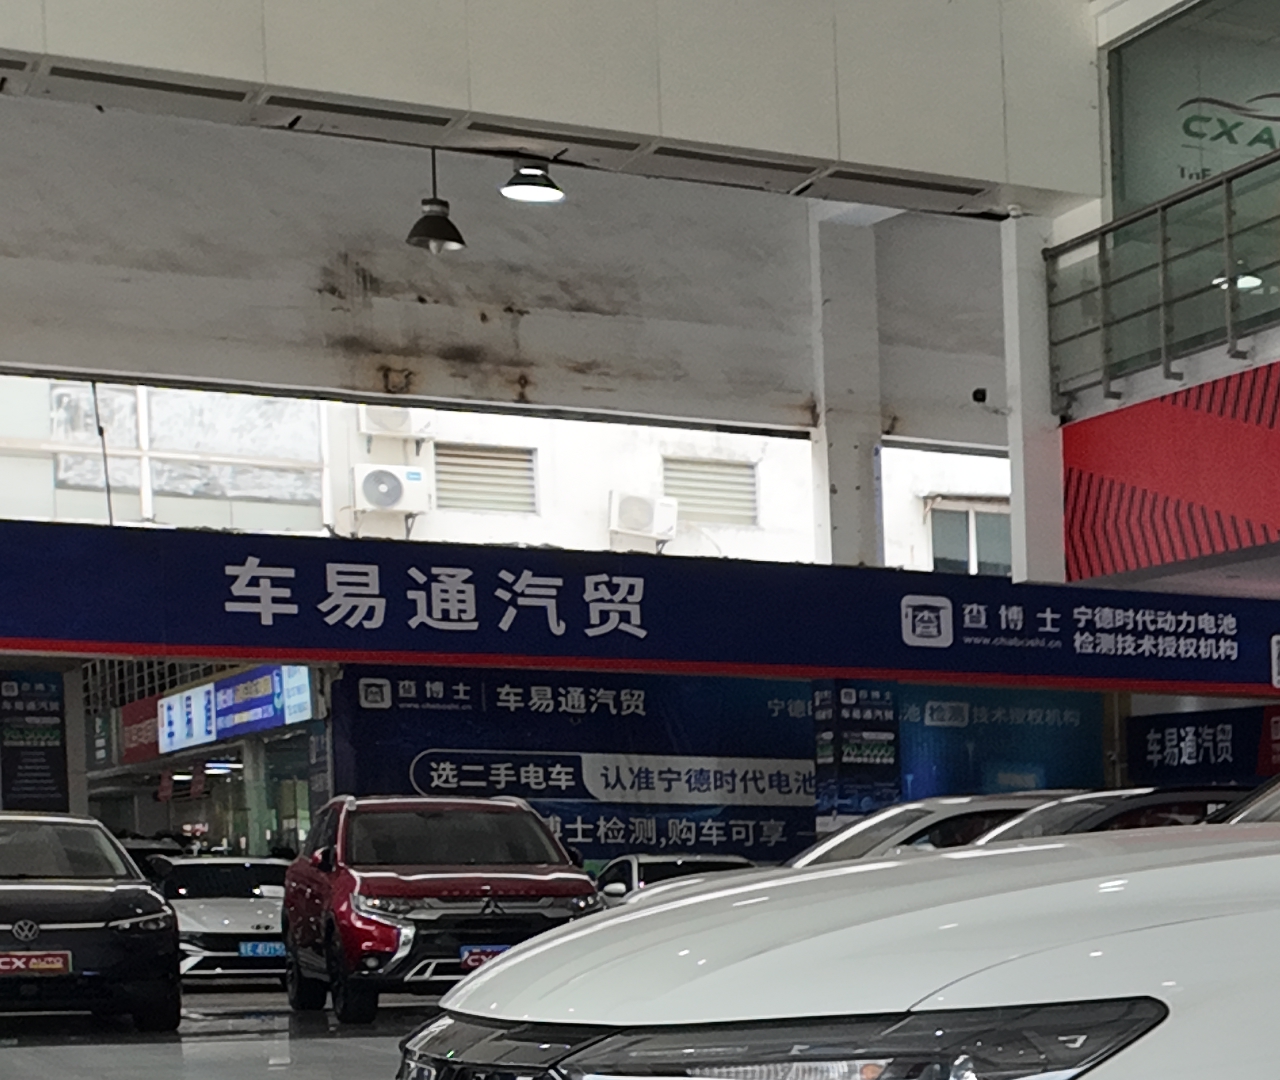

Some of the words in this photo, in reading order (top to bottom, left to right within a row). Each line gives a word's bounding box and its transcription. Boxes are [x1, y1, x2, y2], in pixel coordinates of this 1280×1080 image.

[1182, 114, 1244, 145] CX
[224, 556, 649, 639] 车易通汽贸
[962, 603, 1061, 633] 查博士
[1072, 606, 1237, 635] 宁德时代动力电池
[1073, 632, 1238, 661] 检测技术授权机构
[397, 679, 472, 700] 查博士
[496, 684, 647, 716] 车易通汽贸
[1146, 723, 1233, 768] 车易通汽贸
[430, 761, 576, 790] 选二手电车
[600, 765, 816, 796] 认准宁德时代电池
